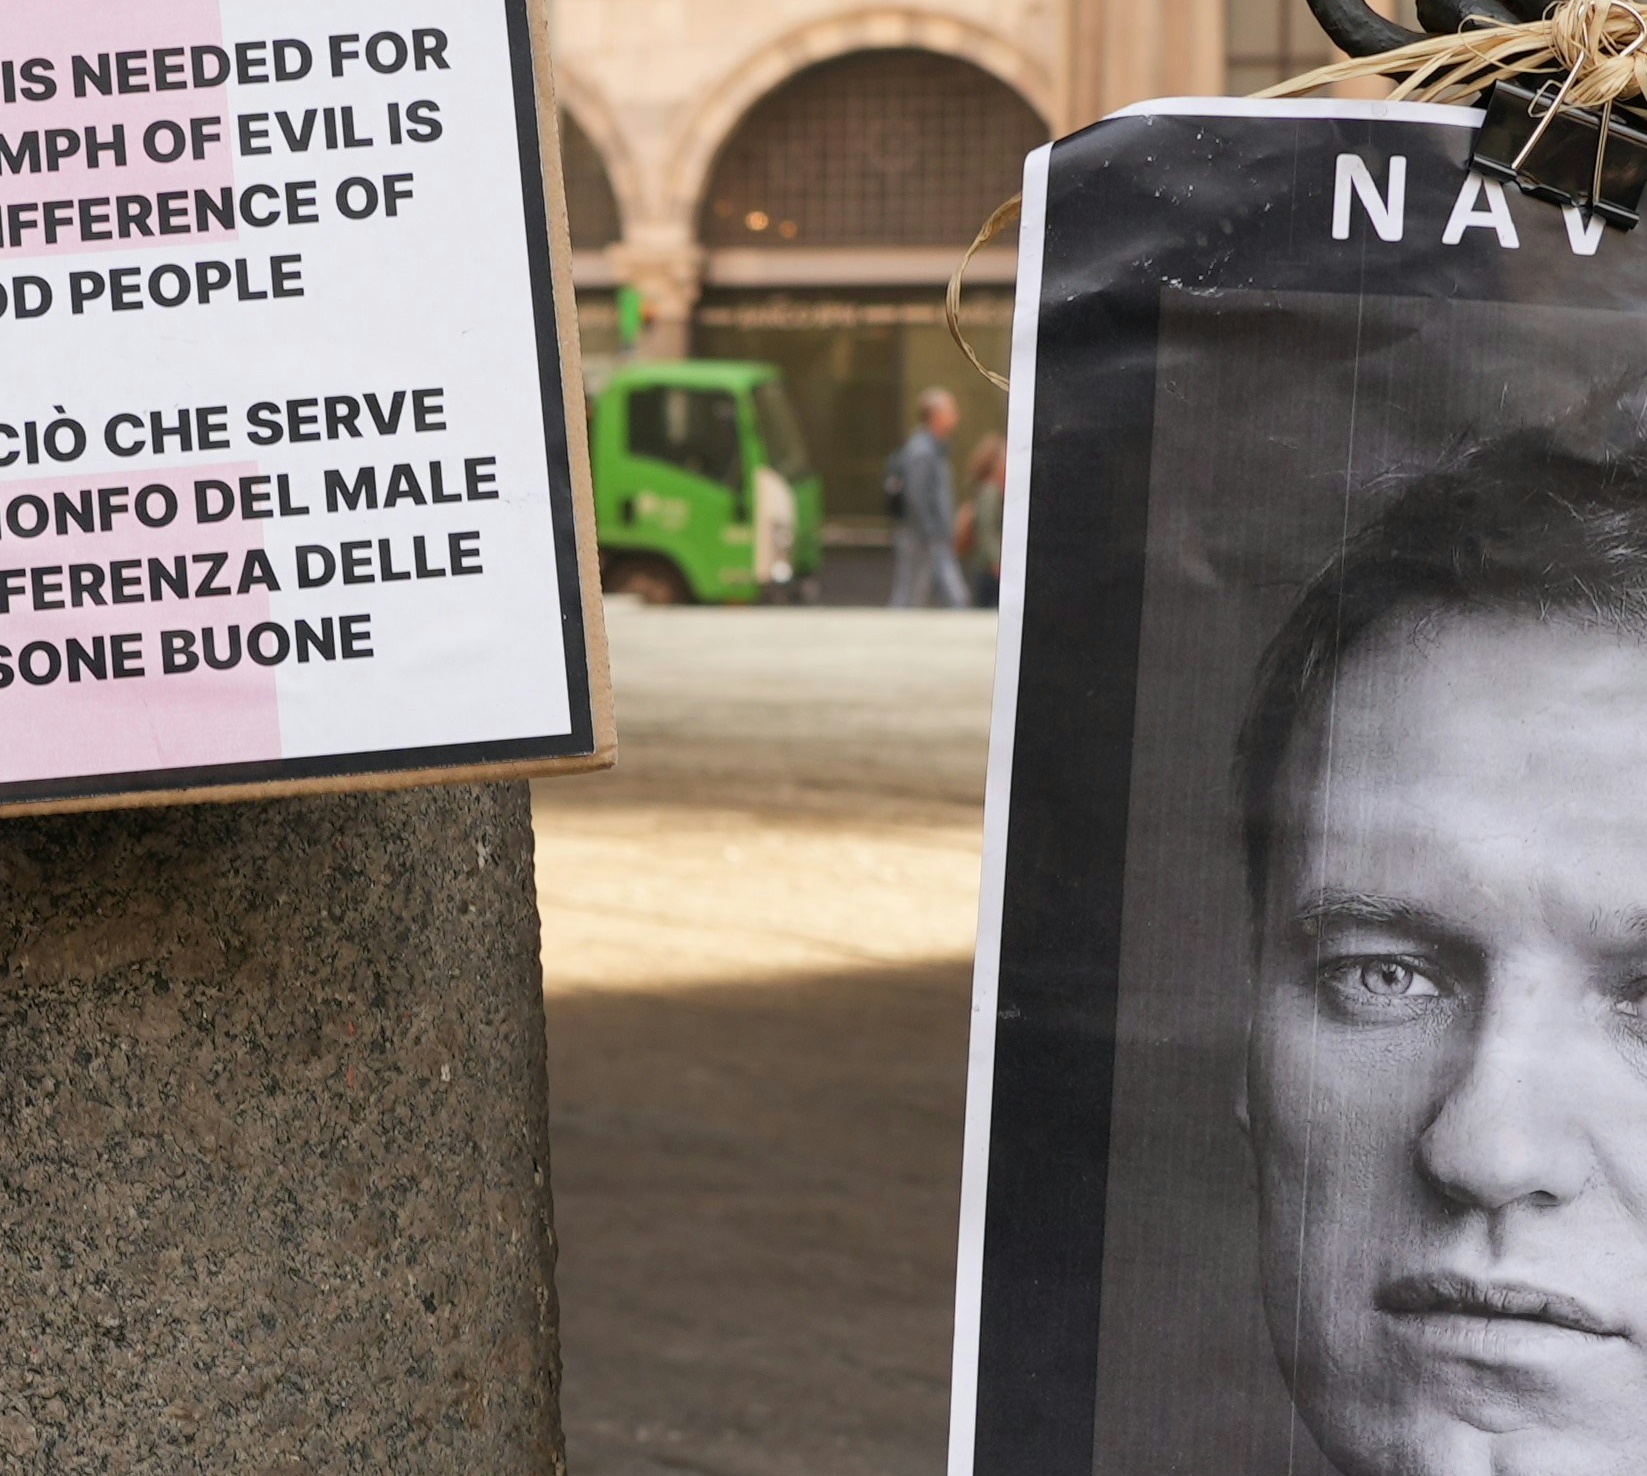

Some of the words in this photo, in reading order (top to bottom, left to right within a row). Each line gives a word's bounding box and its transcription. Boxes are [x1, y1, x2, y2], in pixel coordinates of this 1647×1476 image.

[2, 58, 56, 103] IS
[72, 39, 312, 97] NEEDED
[329, 29, 450, 77] FOR
[143, 117, 220, 162] OF
[238, 107, 373, 155] EVIL
[388, 101, 442, 144] IS
[336, 173, 413, 219] OF
[70, 254, 304, 314] PEOPLE
[105, 406, 230, 456] CHE
[247, 388, 446, 445] SERVE
[194, 474, 309, 523] DEL
[324, 457, 498, 512] MALE
[296, 531, 482, 588] DELLE
[161, 614, 373, 674] BUONE
